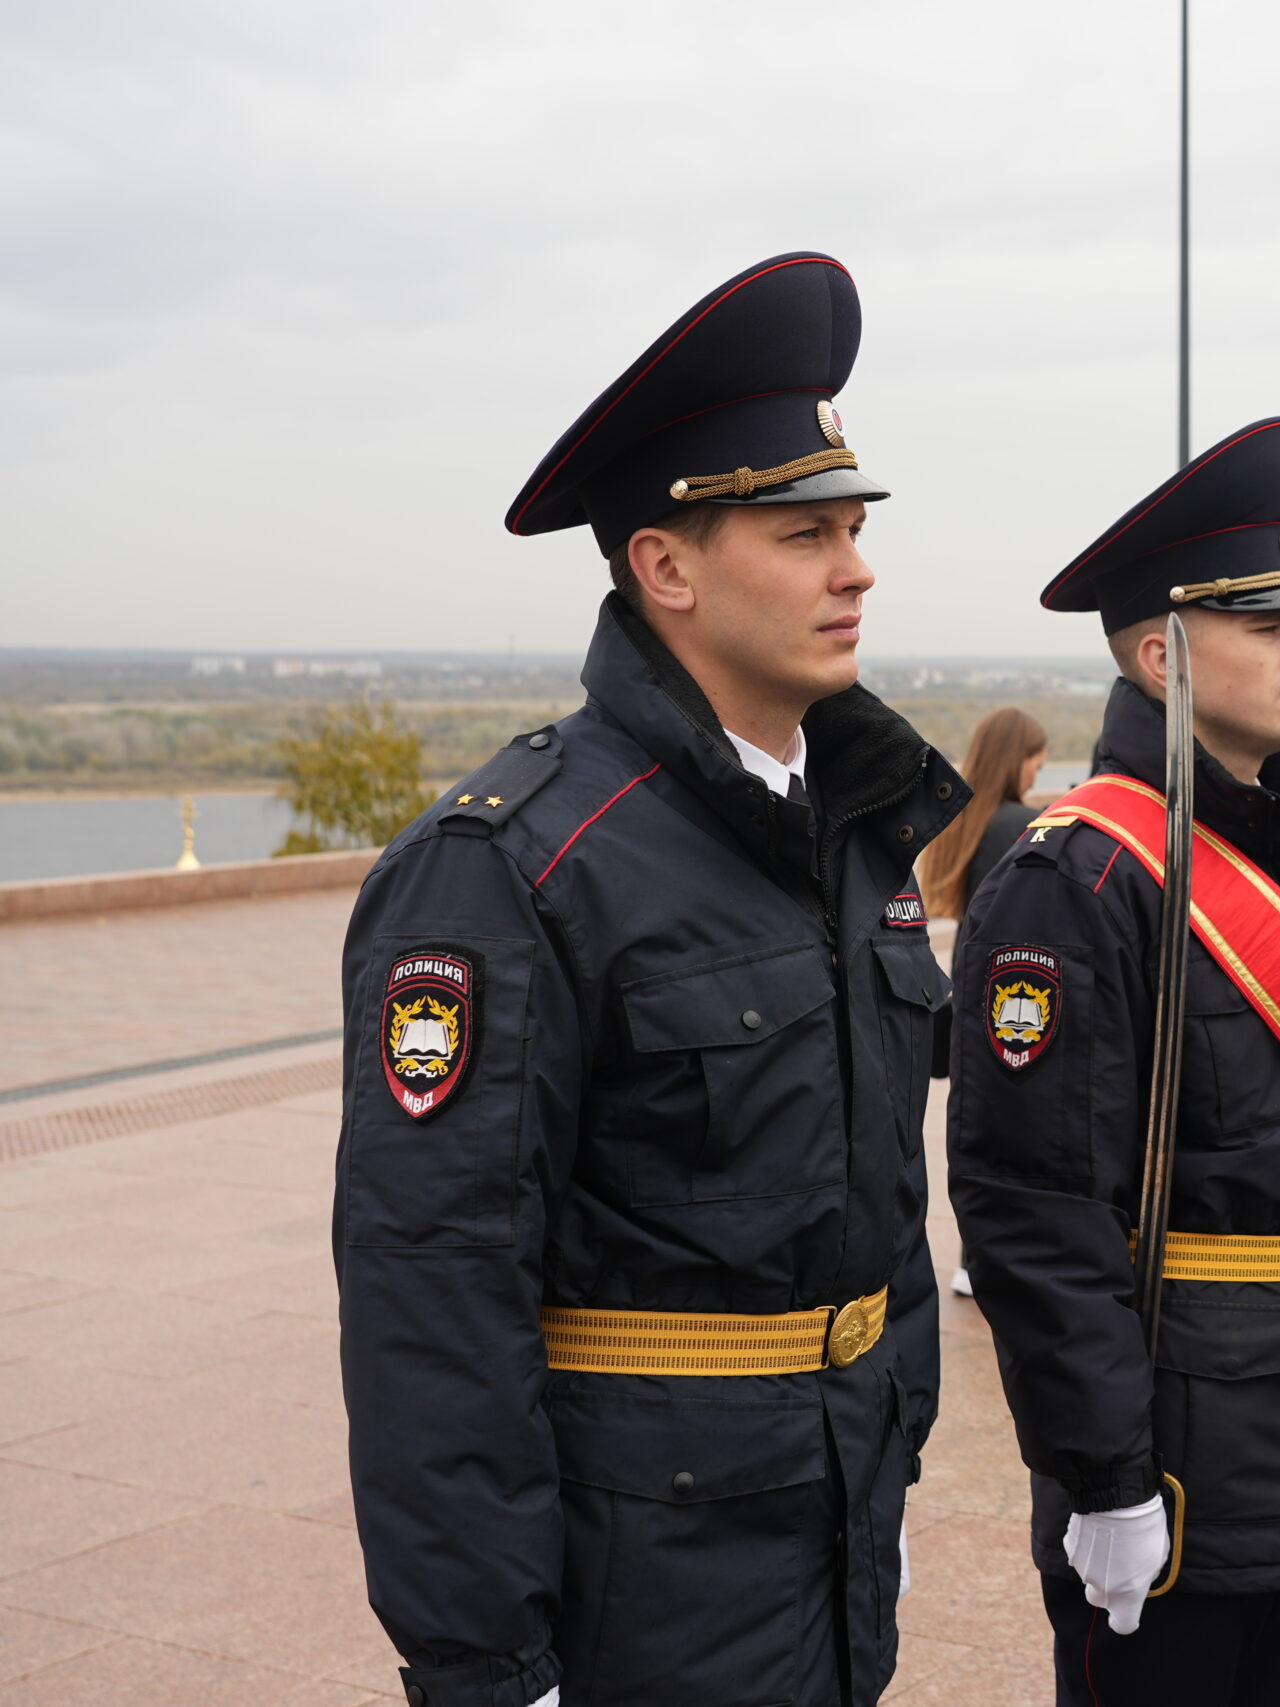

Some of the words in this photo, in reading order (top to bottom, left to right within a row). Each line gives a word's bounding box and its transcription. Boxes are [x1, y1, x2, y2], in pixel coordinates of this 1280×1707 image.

[996, 951, 1056, 970] ПОЛИЦИЯ
[394, 960, 464, 984] ПОЛИЦИЯ
[1003, 1048, 1030, 1068] МВД
[402, 1089, 434, 1115] МВД
